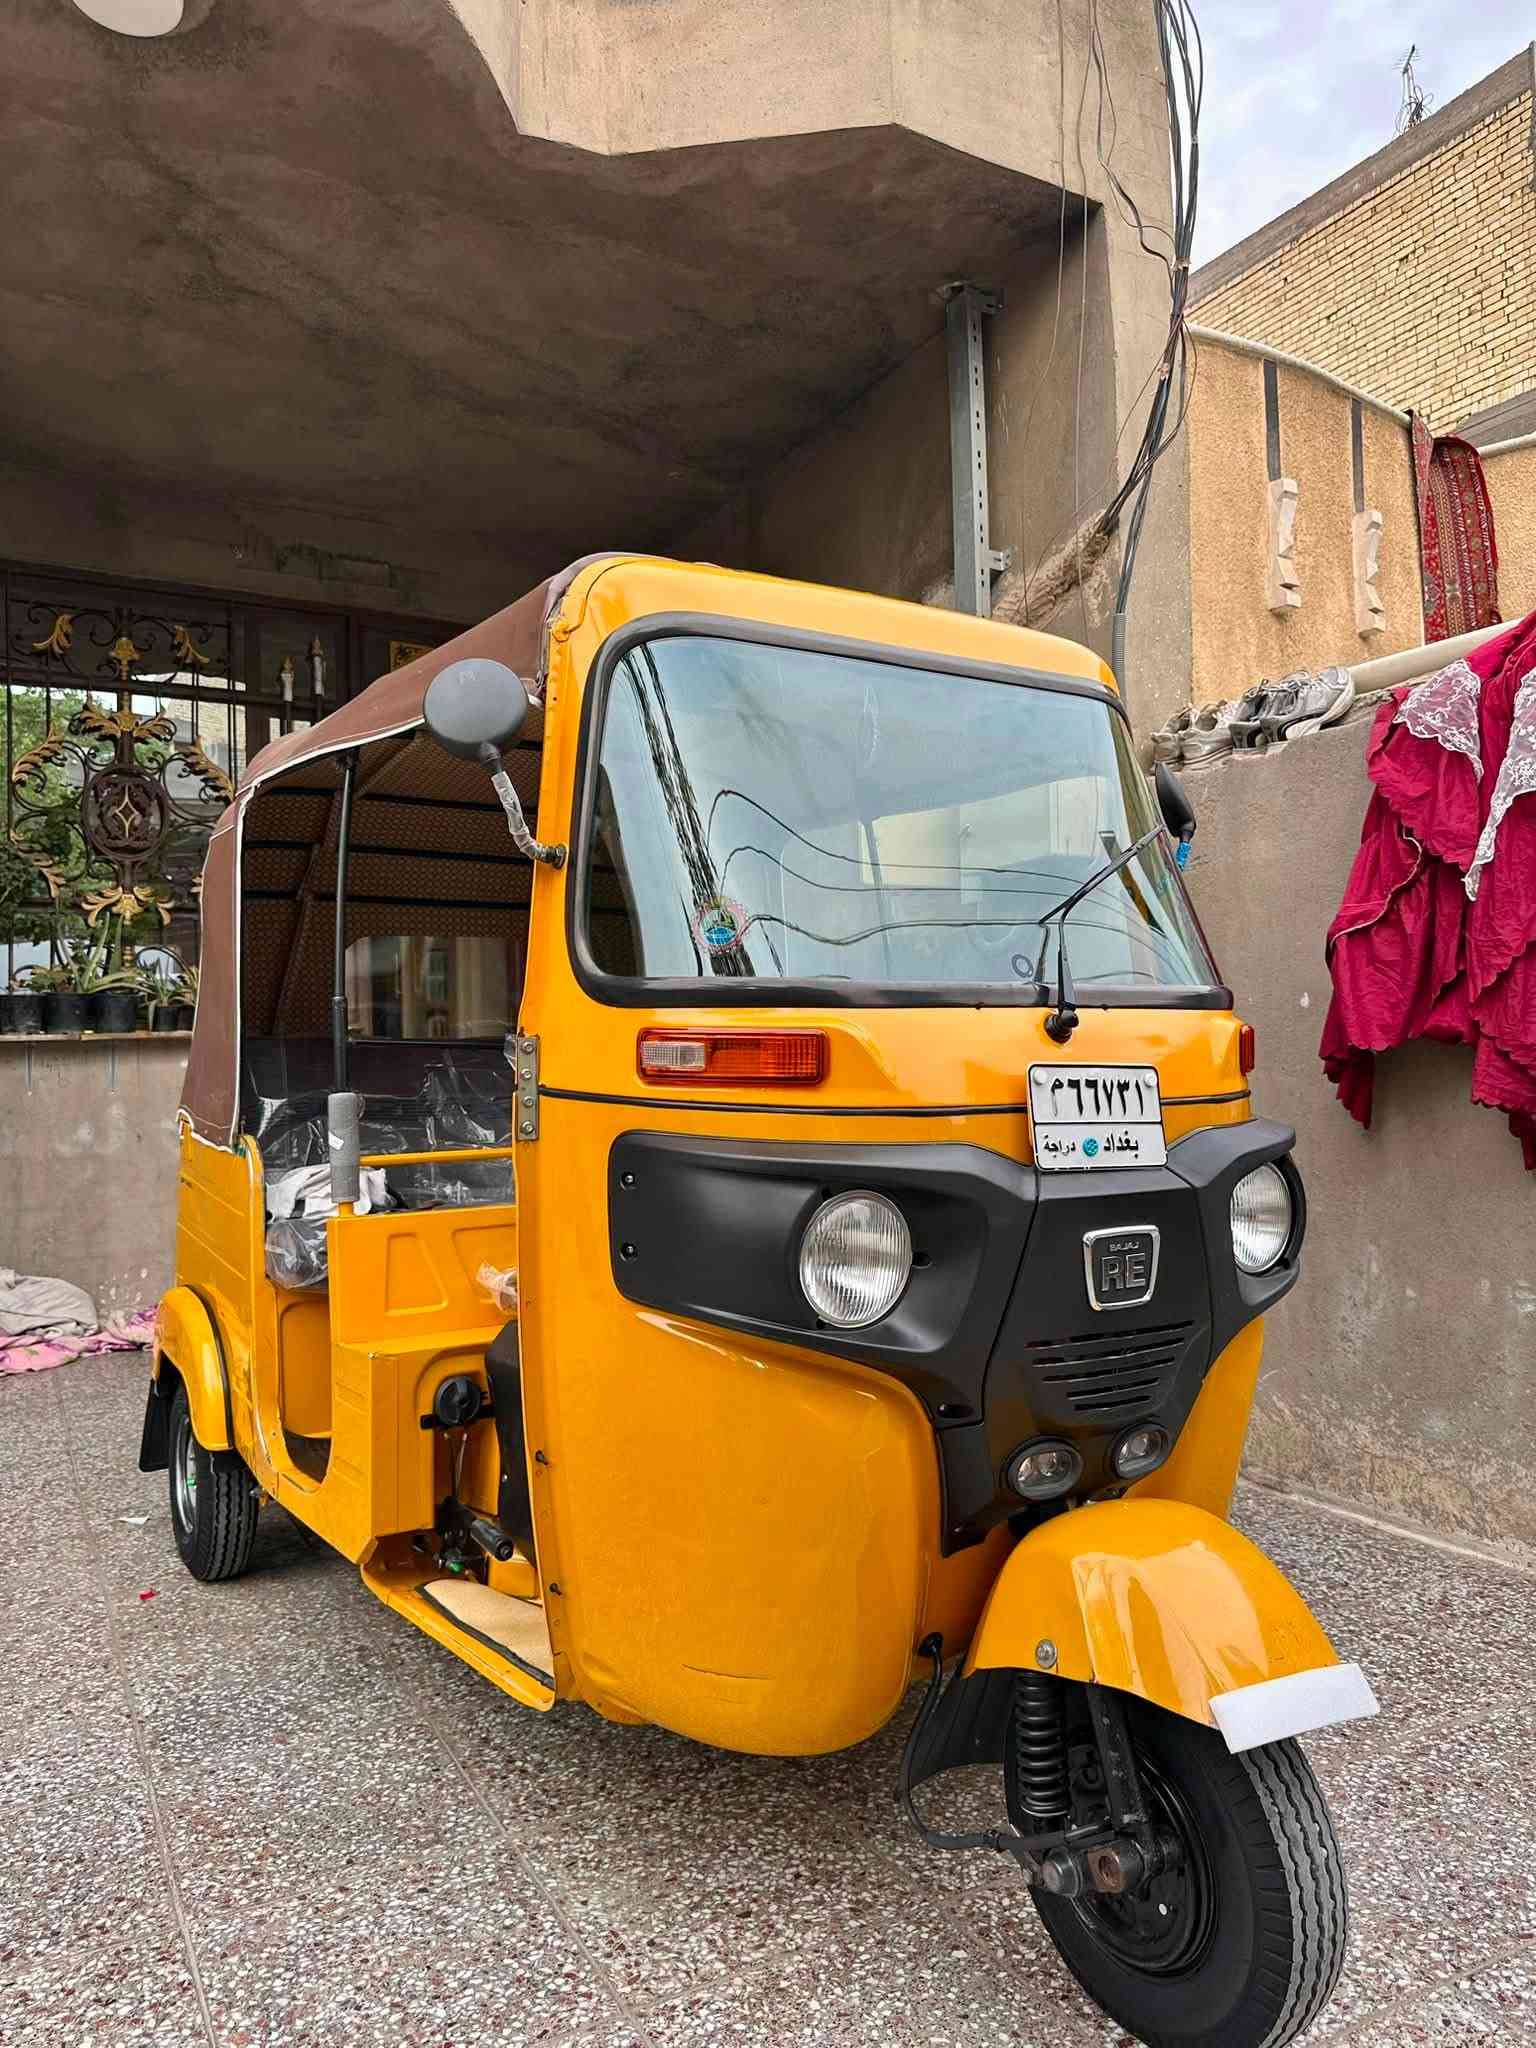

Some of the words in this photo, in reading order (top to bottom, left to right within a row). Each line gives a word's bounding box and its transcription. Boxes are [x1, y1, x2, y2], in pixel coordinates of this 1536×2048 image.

[1042, 1134, 1077, 1158] دراجة
[1103, 1130, 1139, 1159] بغداد
[1101, 1252, 1146, 1292] RE
